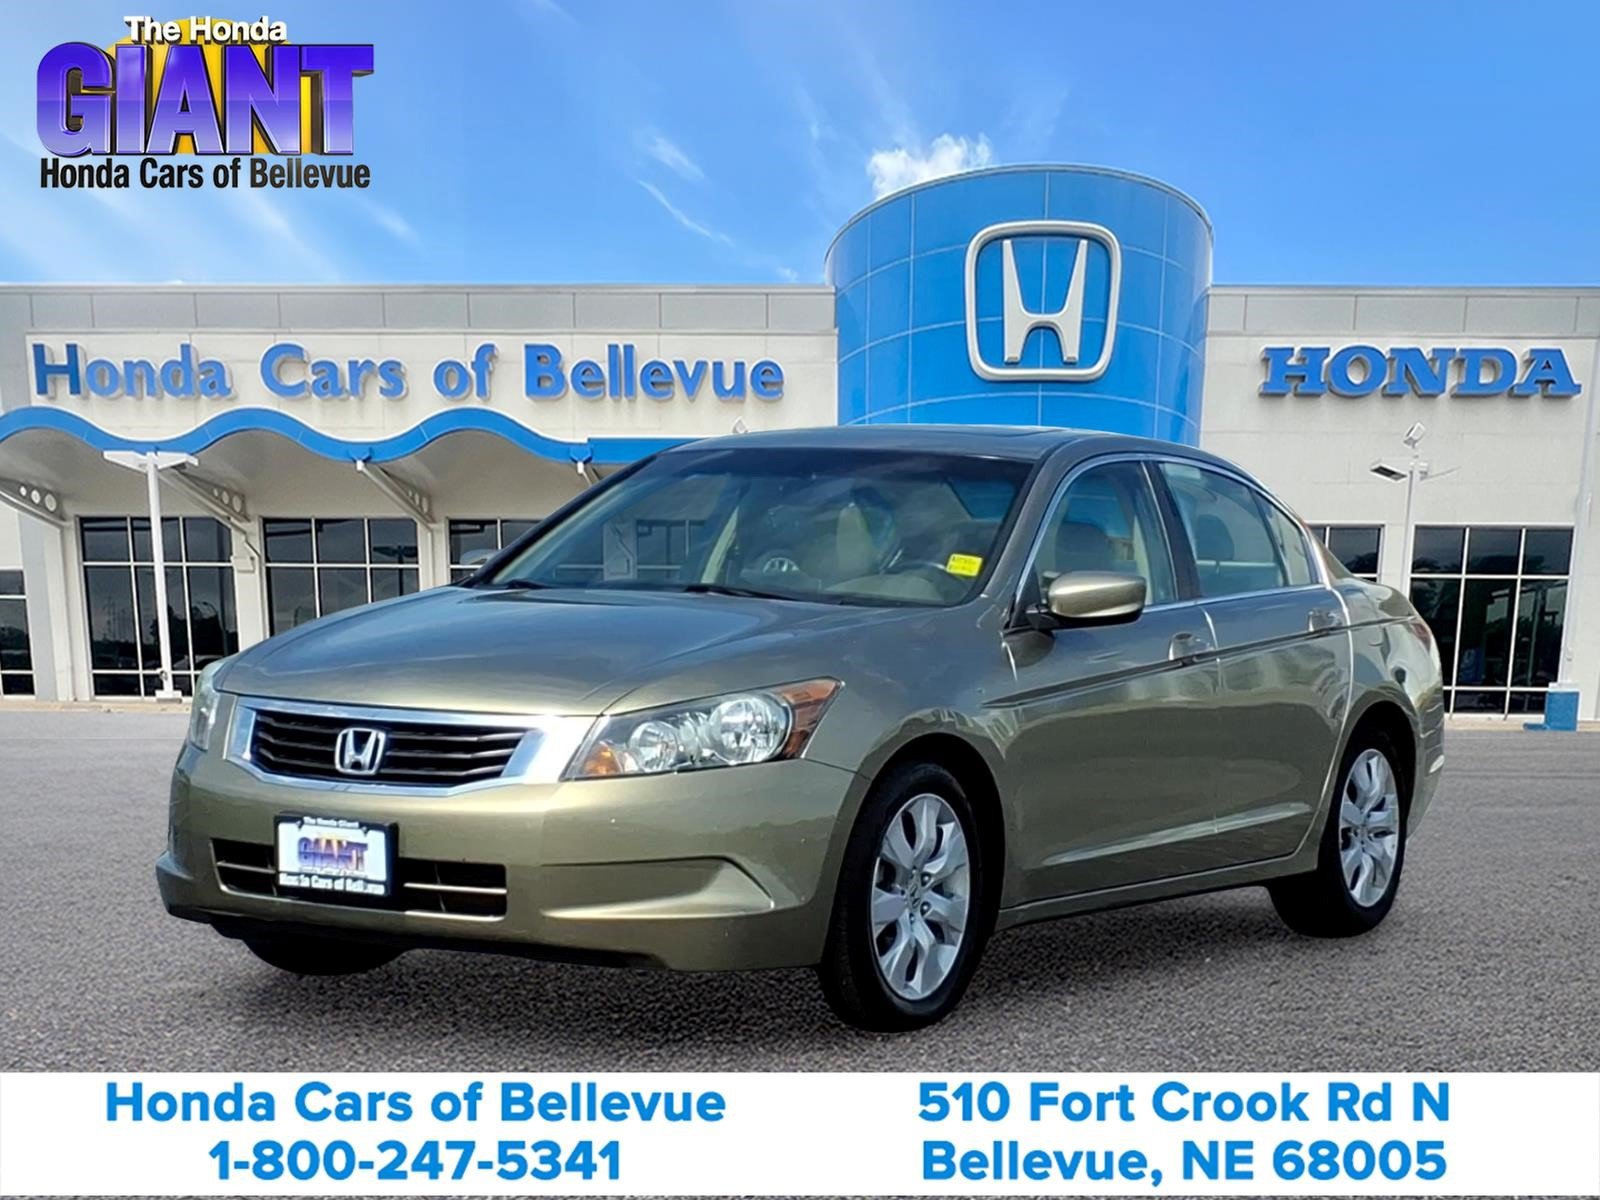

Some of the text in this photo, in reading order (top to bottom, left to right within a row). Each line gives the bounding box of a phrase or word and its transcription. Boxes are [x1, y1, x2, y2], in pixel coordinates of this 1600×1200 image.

[32, 342, 785, 403] Honda Cars of Bellevue
[1258, 345, 1582, 398] HONDA
[298, 837, 368, 870] GIANT
